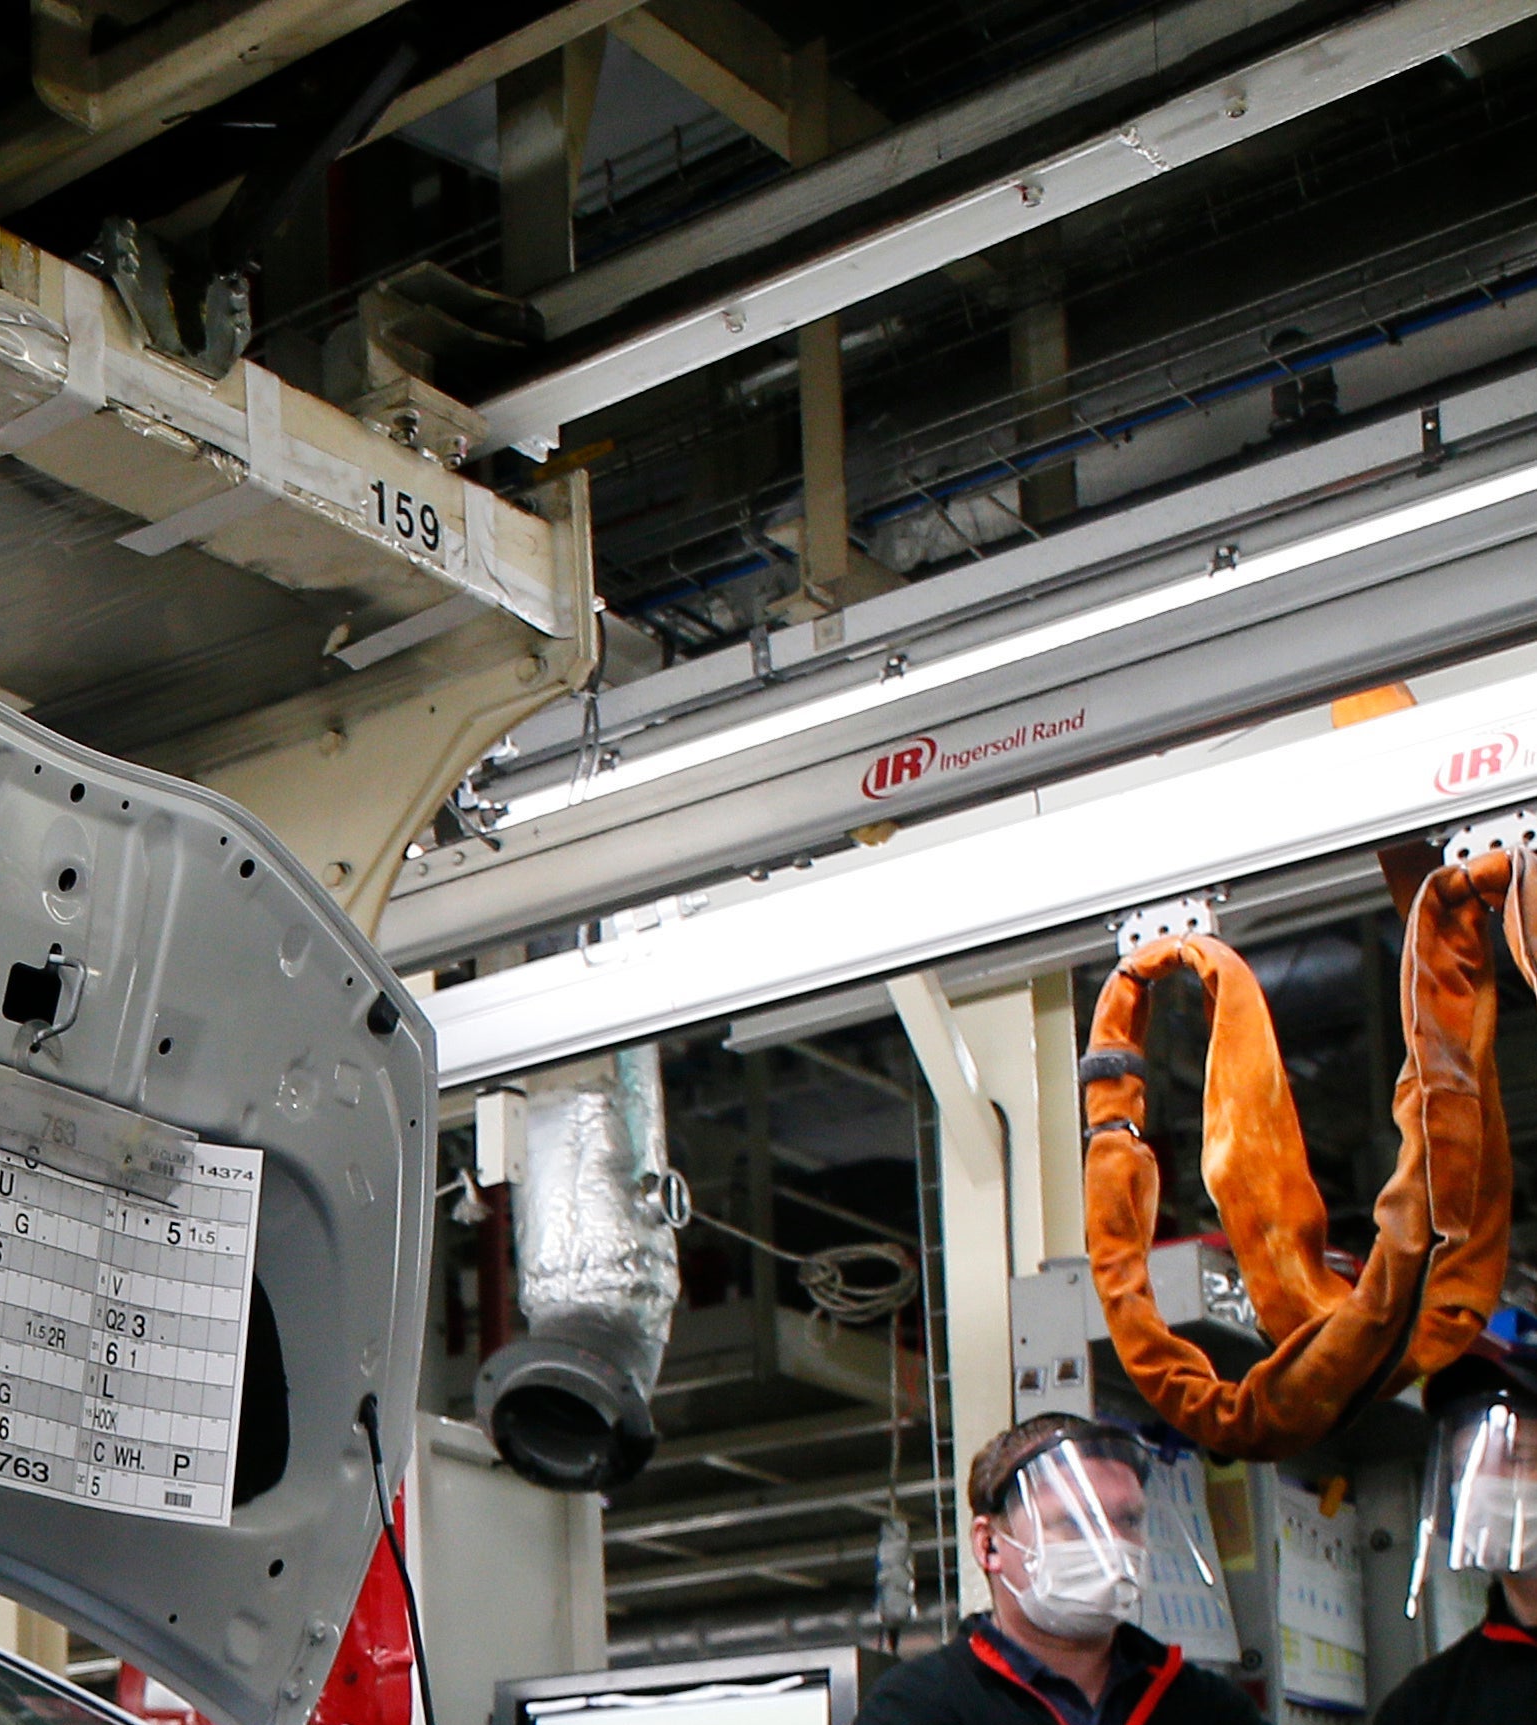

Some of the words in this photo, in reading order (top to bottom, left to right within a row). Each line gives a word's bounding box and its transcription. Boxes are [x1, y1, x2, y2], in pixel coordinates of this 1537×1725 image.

[369, 478, 441, 552] 159
[939, 726, 1027, 773] Ingersoll
[1031, 708, 1086, 743] Rand
[197, 1163, 255, 1182] 14374
[15, 1212, 30, 1236] G
[166, 1220, 182, 1246] 5
[113, 1274, 124, 1297] V
[106, 1308, 127, 1332] Q2
[131, 1314, 146, 1339] 3
[48, 1326, 67, 1350] 2R
[106, 1341, 119, 1366] 6
[102, 1373, 115, 1399] L
[93, 1406, 120, 1433] HOOK
[93, 1441, 106, 1463] C
[173, 1453, 191, 1478] P
[90, 1475, 101, 1497] 5
